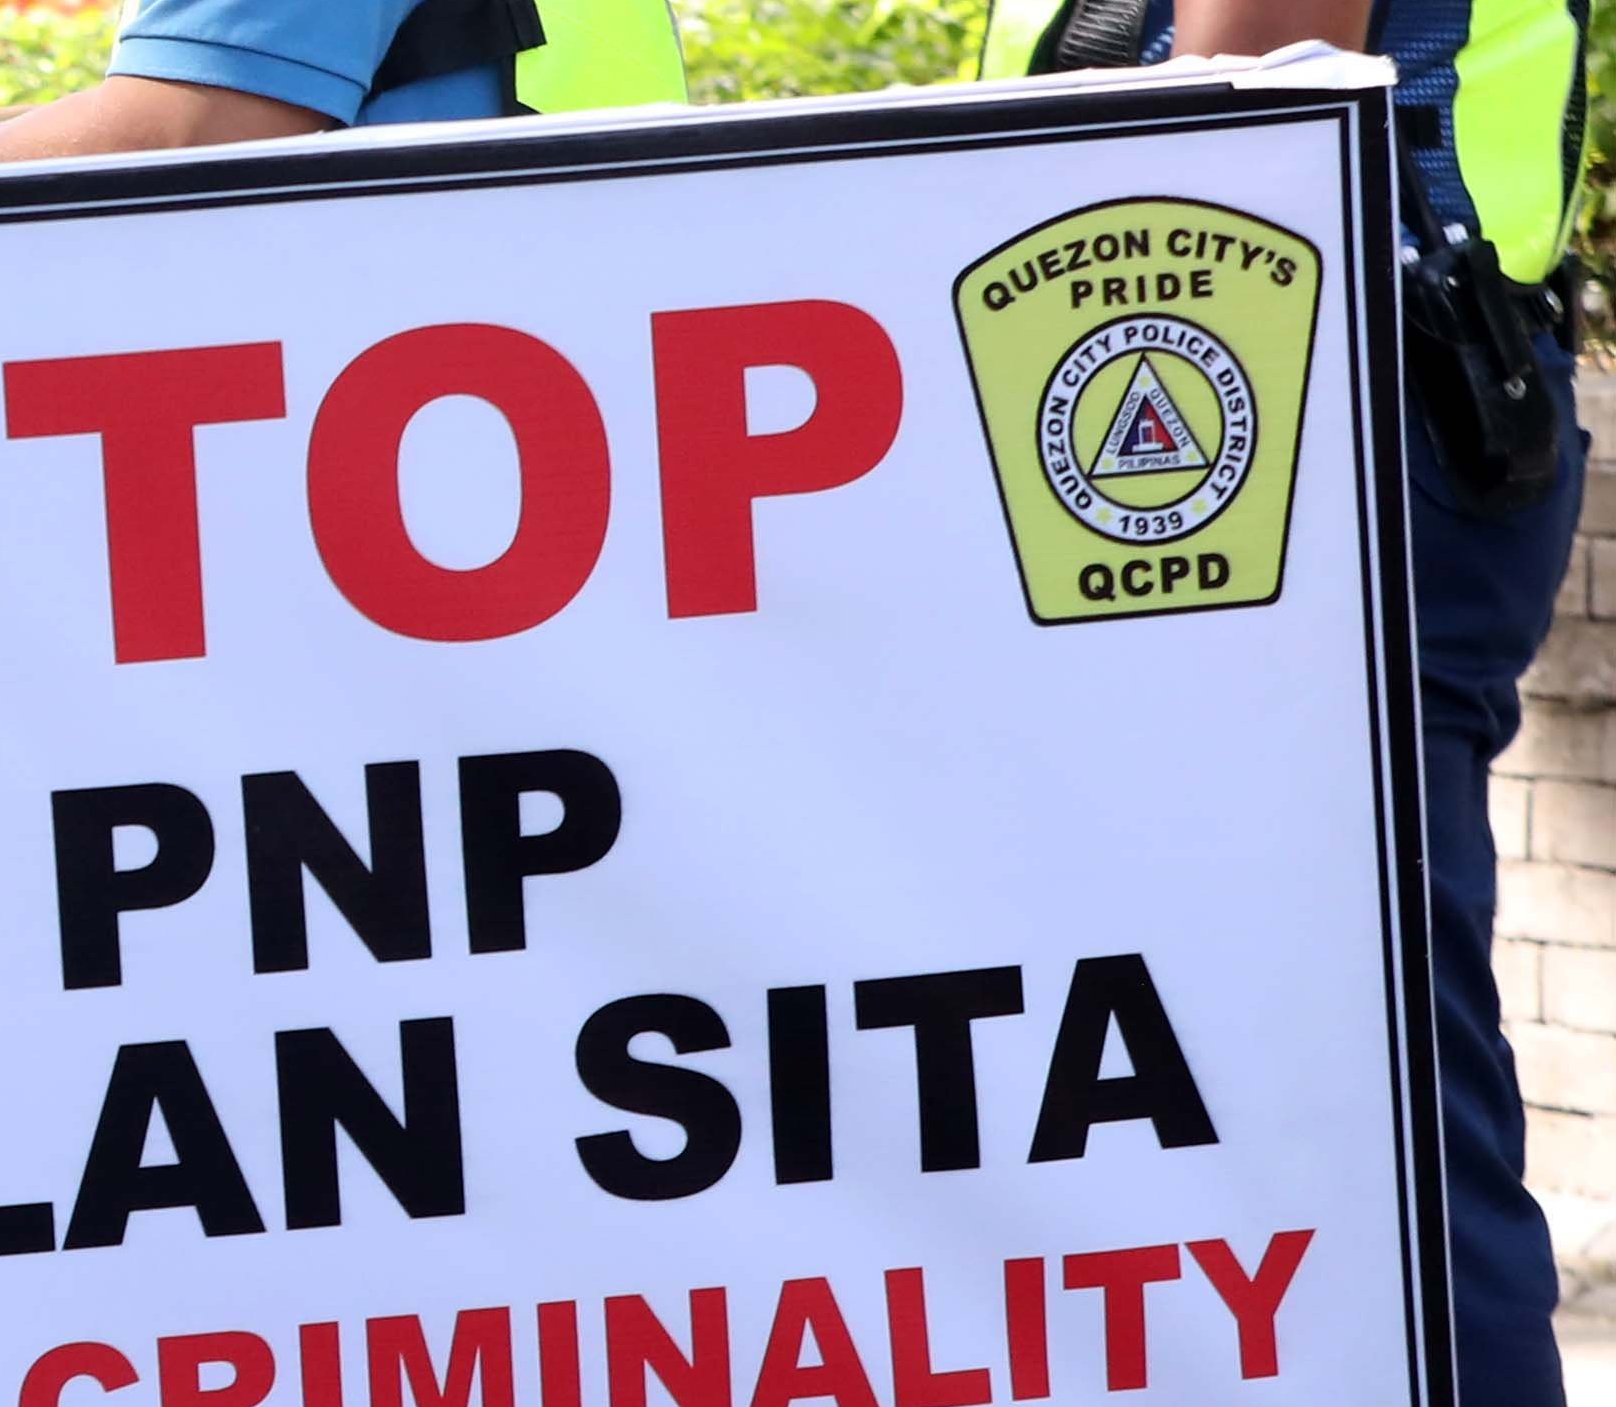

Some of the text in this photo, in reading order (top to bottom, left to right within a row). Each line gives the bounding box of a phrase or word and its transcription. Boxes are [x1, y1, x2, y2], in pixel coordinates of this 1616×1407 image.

[982, 229, 1297, 312] QUEZON CITY'S
[1071, 270, 1214, 310] PRIDE
[1046, 324, 1249, 511] QUEZON CITY POLICE DISTRICT
[1150, 388, 1190, 448] QUEZON
[1119, 511, 1184, 536] 1939
[1078, 553, 1230, 602] QCPD
[51, 749, 621, 990] PNP
[575, 953, 1219, 1201] SITA
